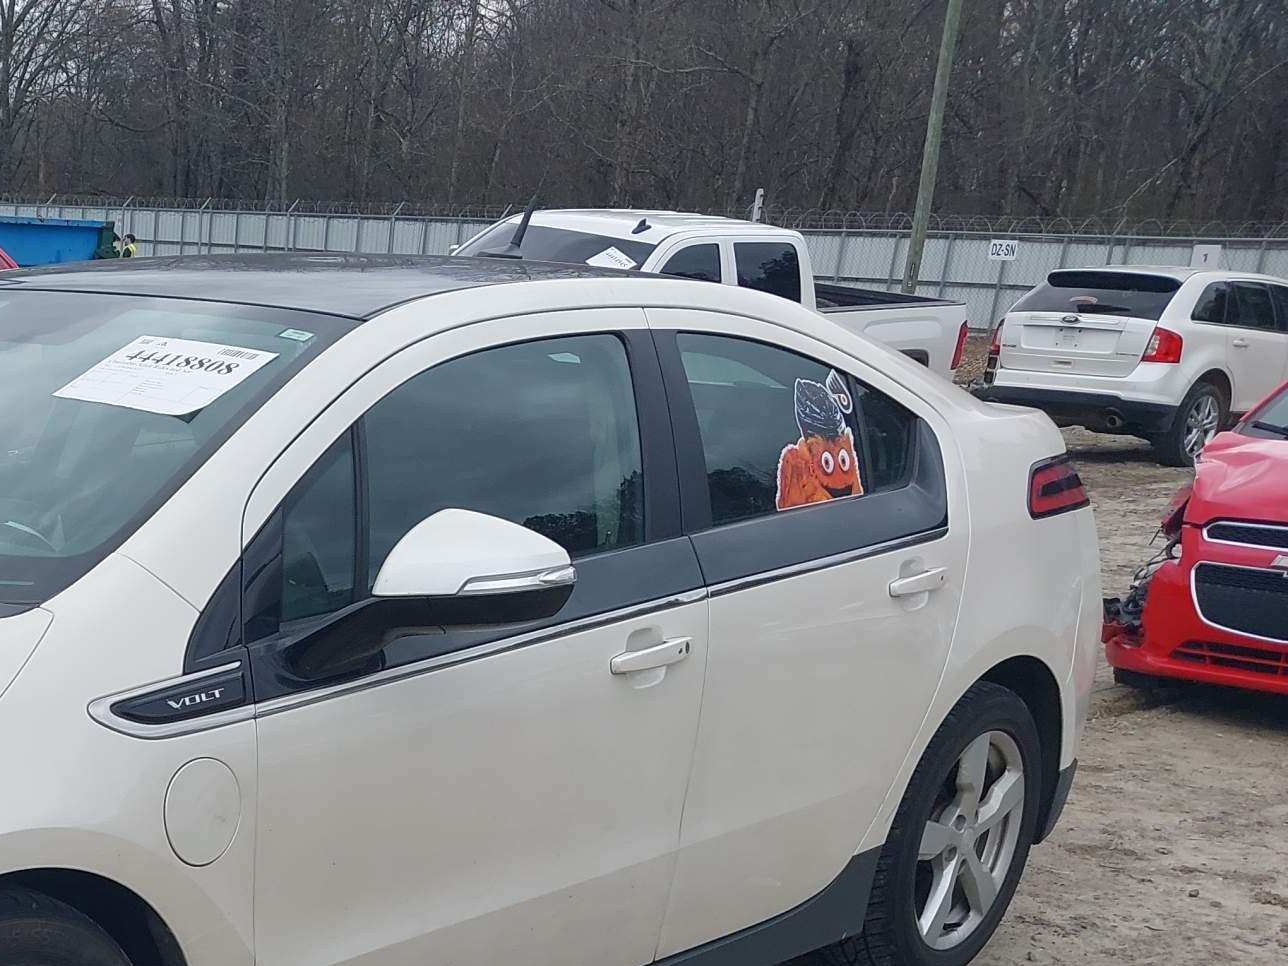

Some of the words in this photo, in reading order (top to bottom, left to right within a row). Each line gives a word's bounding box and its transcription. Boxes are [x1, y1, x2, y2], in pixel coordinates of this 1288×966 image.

[991, 243, 1016, 256] DZ-SN
[126, 349, 239, 375] 44418808
[167, 687, 226, 710] VOLT
